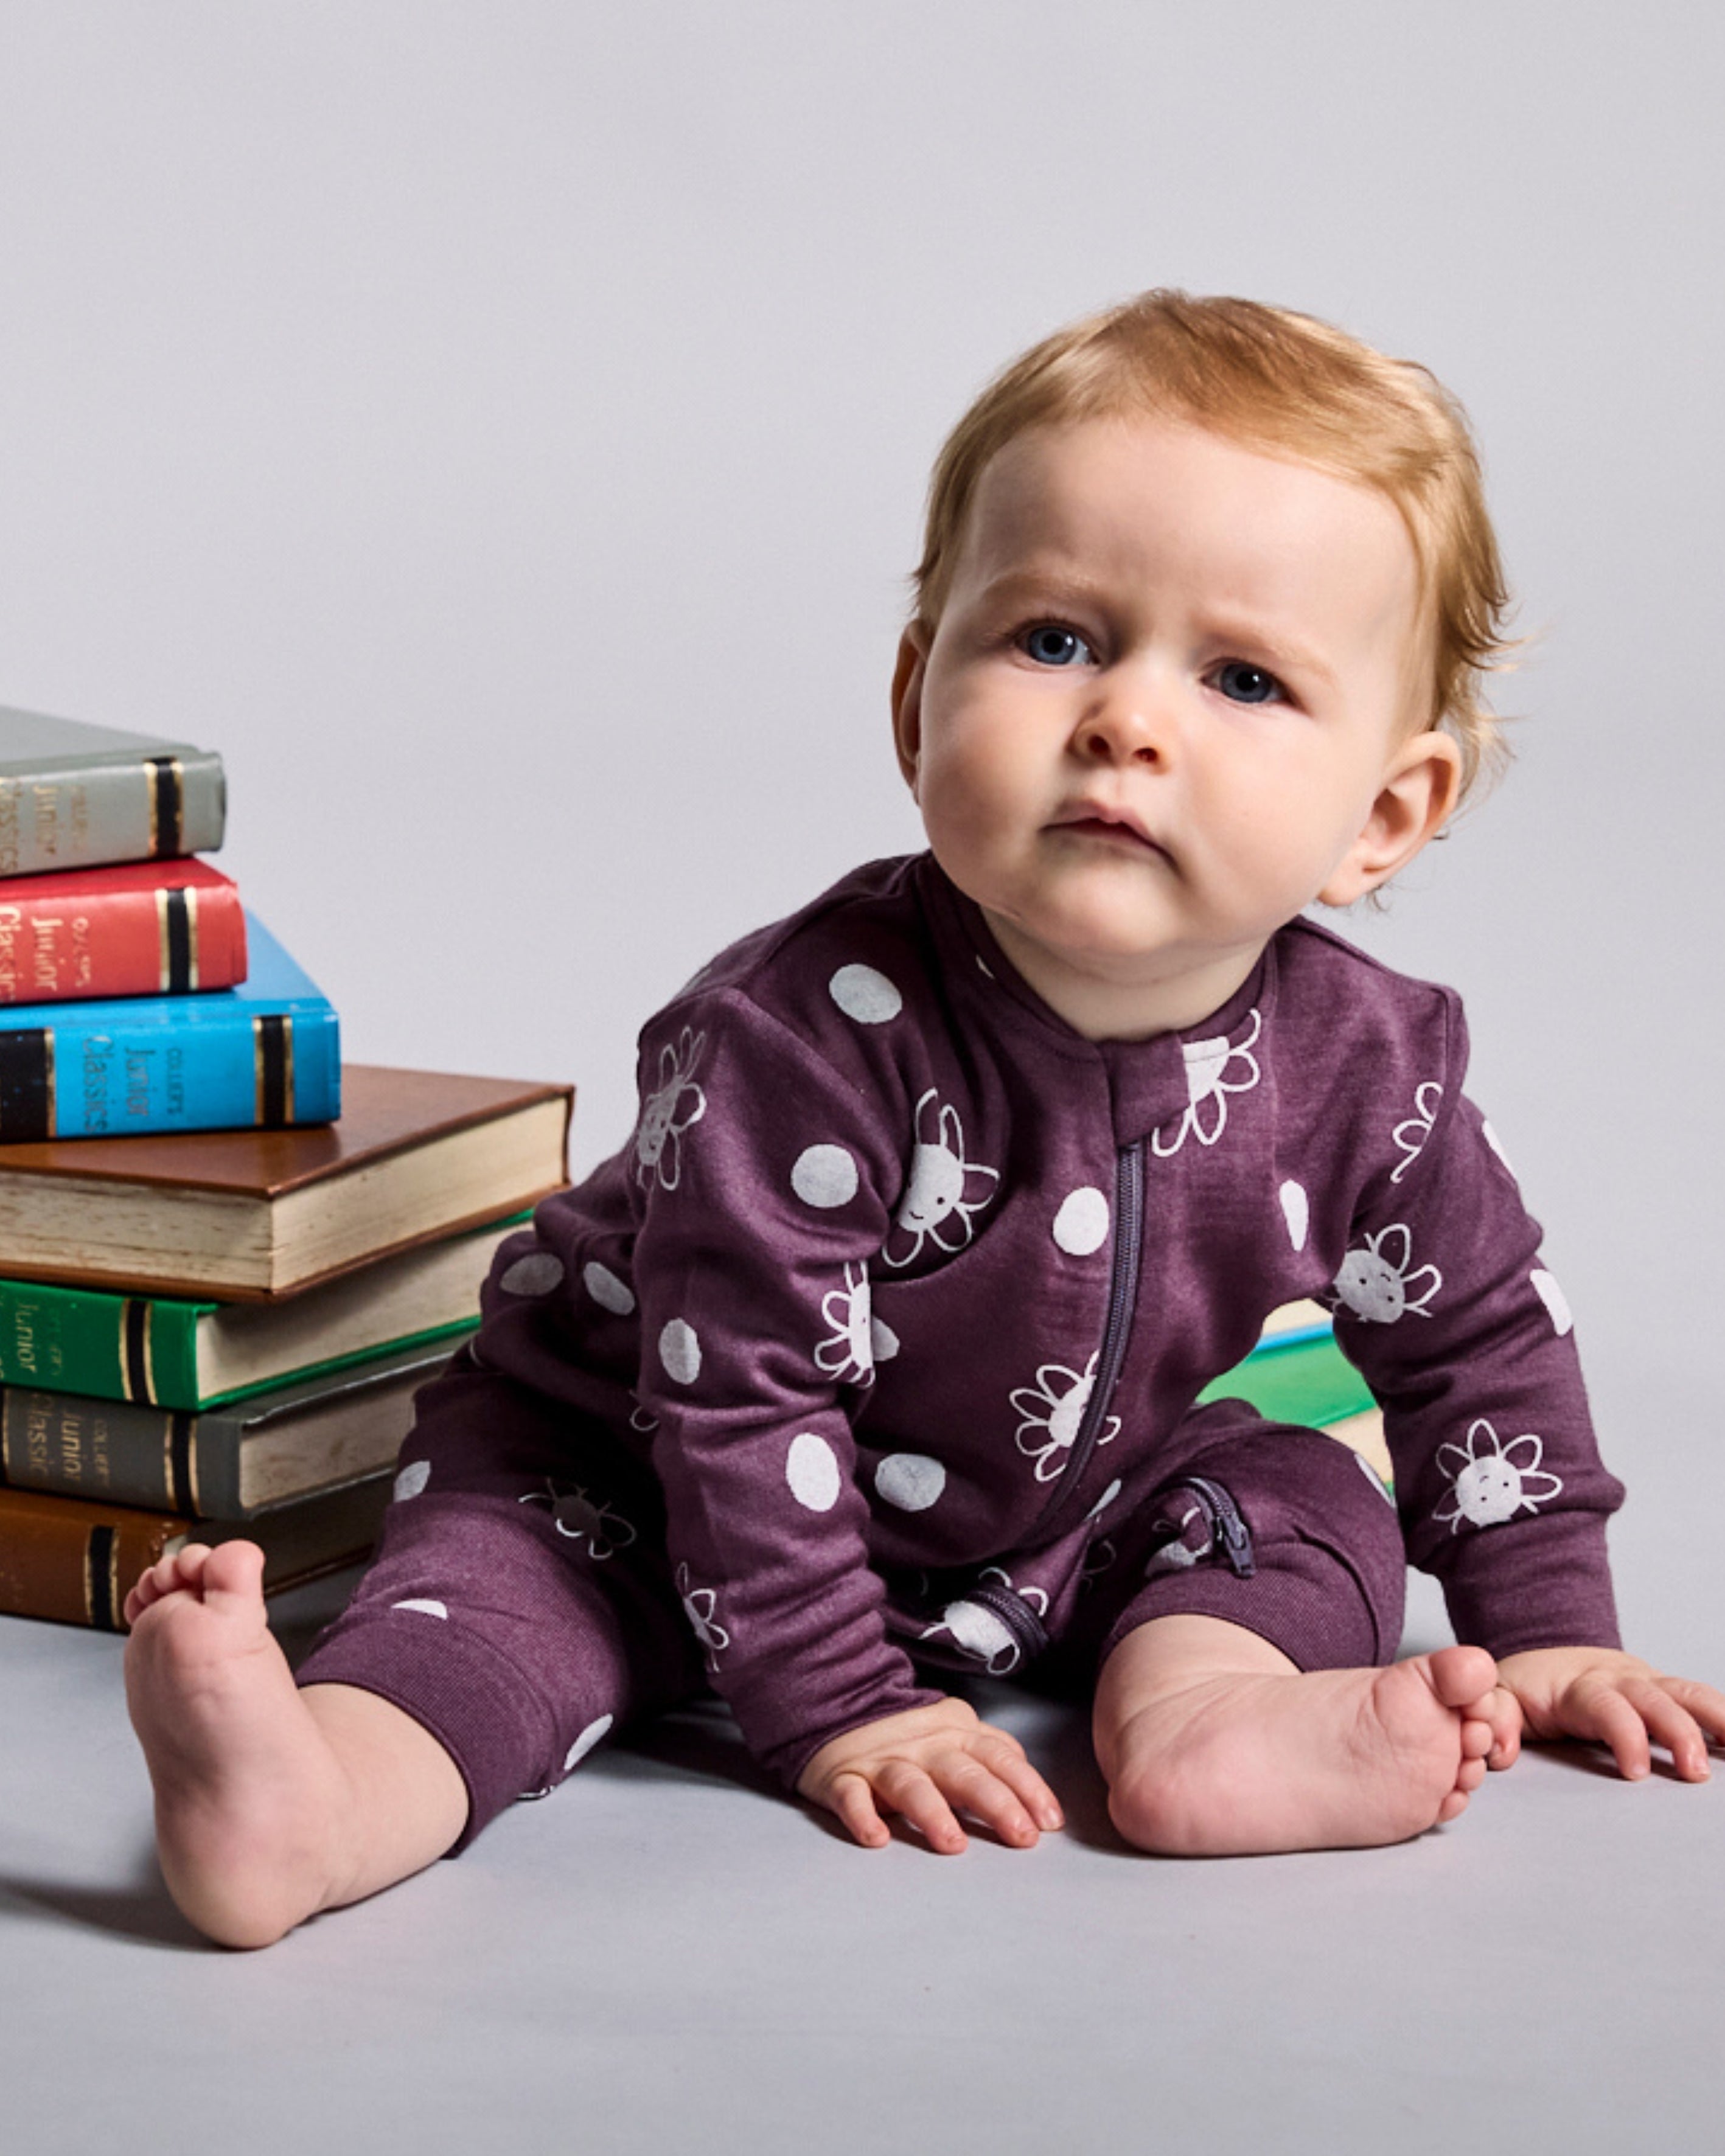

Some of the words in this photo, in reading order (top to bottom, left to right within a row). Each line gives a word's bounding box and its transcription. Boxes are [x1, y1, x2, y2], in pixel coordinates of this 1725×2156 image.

[31, 916, 66, 992] Junior
[83, 1035, 115, 1134] Classics
[125, 1046, 158, 1116] Junior
[15, 1301, 40, 1374] Junior
[61, 1408, 88, 1483] Junior
